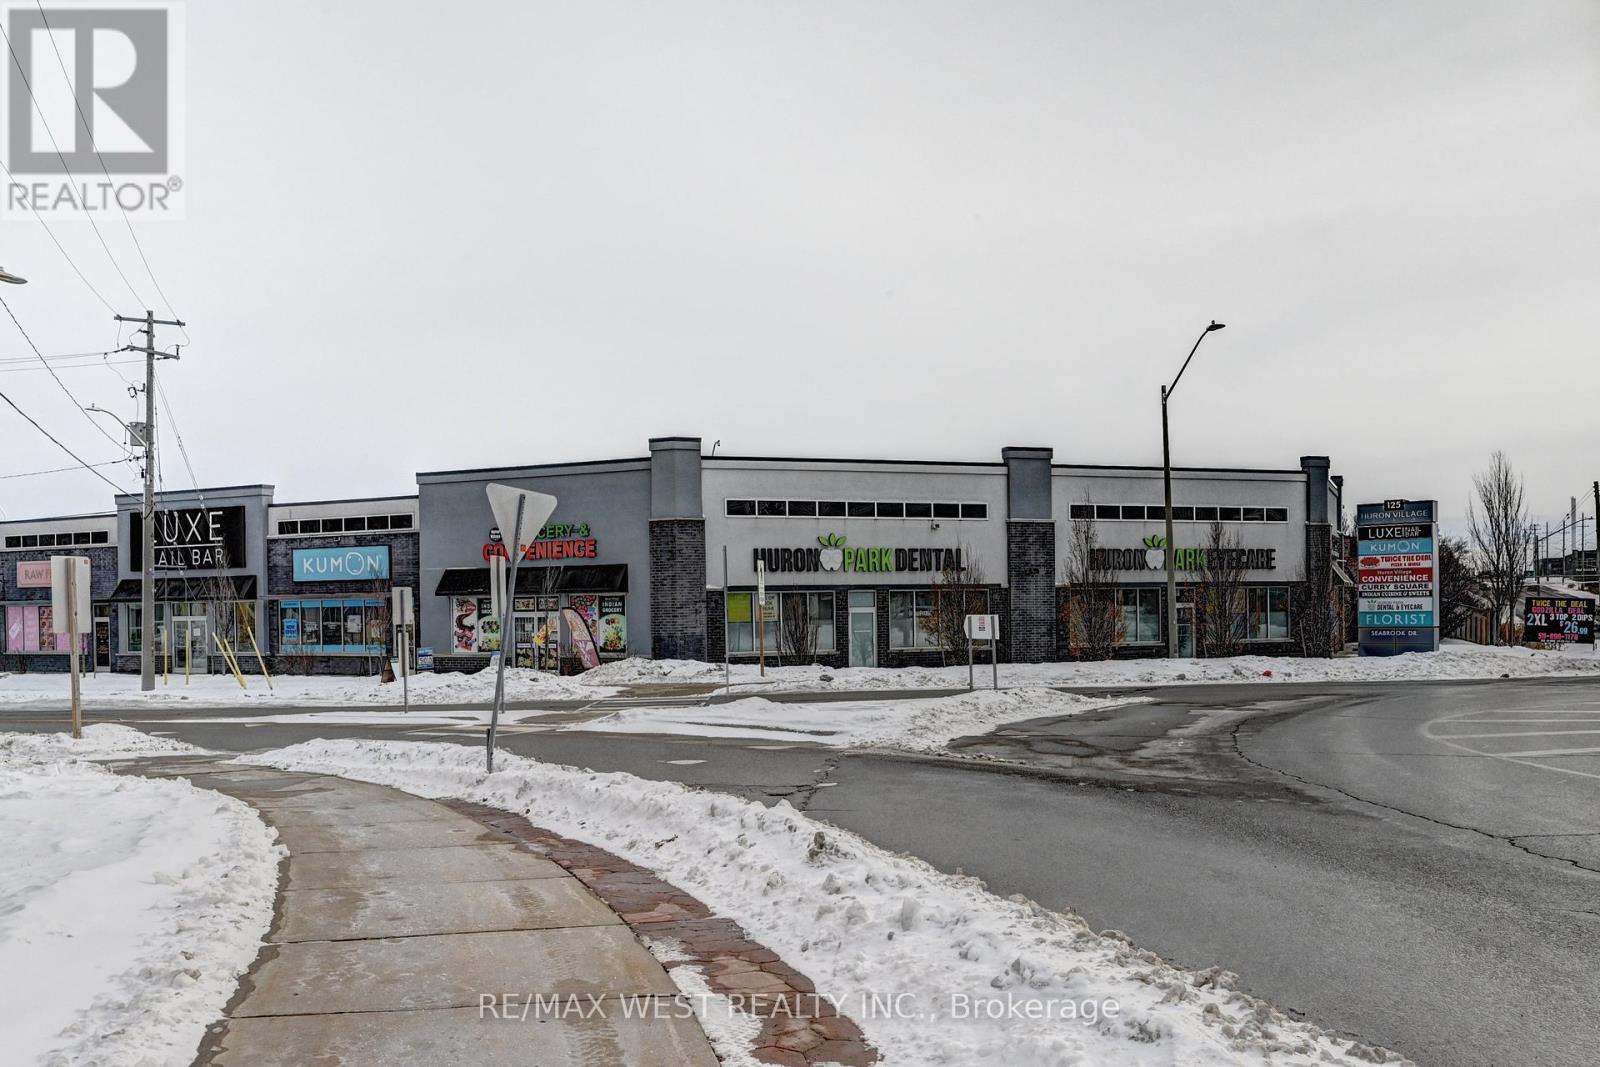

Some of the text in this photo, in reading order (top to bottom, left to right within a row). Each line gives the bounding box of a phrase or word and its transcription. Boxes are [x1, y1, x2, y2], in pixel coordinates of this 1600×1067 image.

[1387, 501, 1401, 509] 125
[1361, 509, 1428, 520] HURON VILLAGE
[154, 511, 223, 542] UXE
[538, 521, 592, 539] CERY &
[1368, 527, 1402, 539] LUXE
[482, 539, 598, 561] COENIENCE
[1370, 541, 1420, 553] KUMON
[157, 548, 223, 567] AIL BAR
[753, 547, 966, 572] HURON PARK DENTAL
[1090, 548, 1147, 571] HURON
[1164, 548, 1207, 571] ARK
[303, 552, 379, 576] KUMON
[25, 568, 43, 580] RAW
[1362, 574, 1429, 583] CONVENIENCE
[1570, 600, 1588, 608] DEAL
[1366, 614, 1426, 625] FLORIST
[1526, 613, 1548, 626] 2XL
